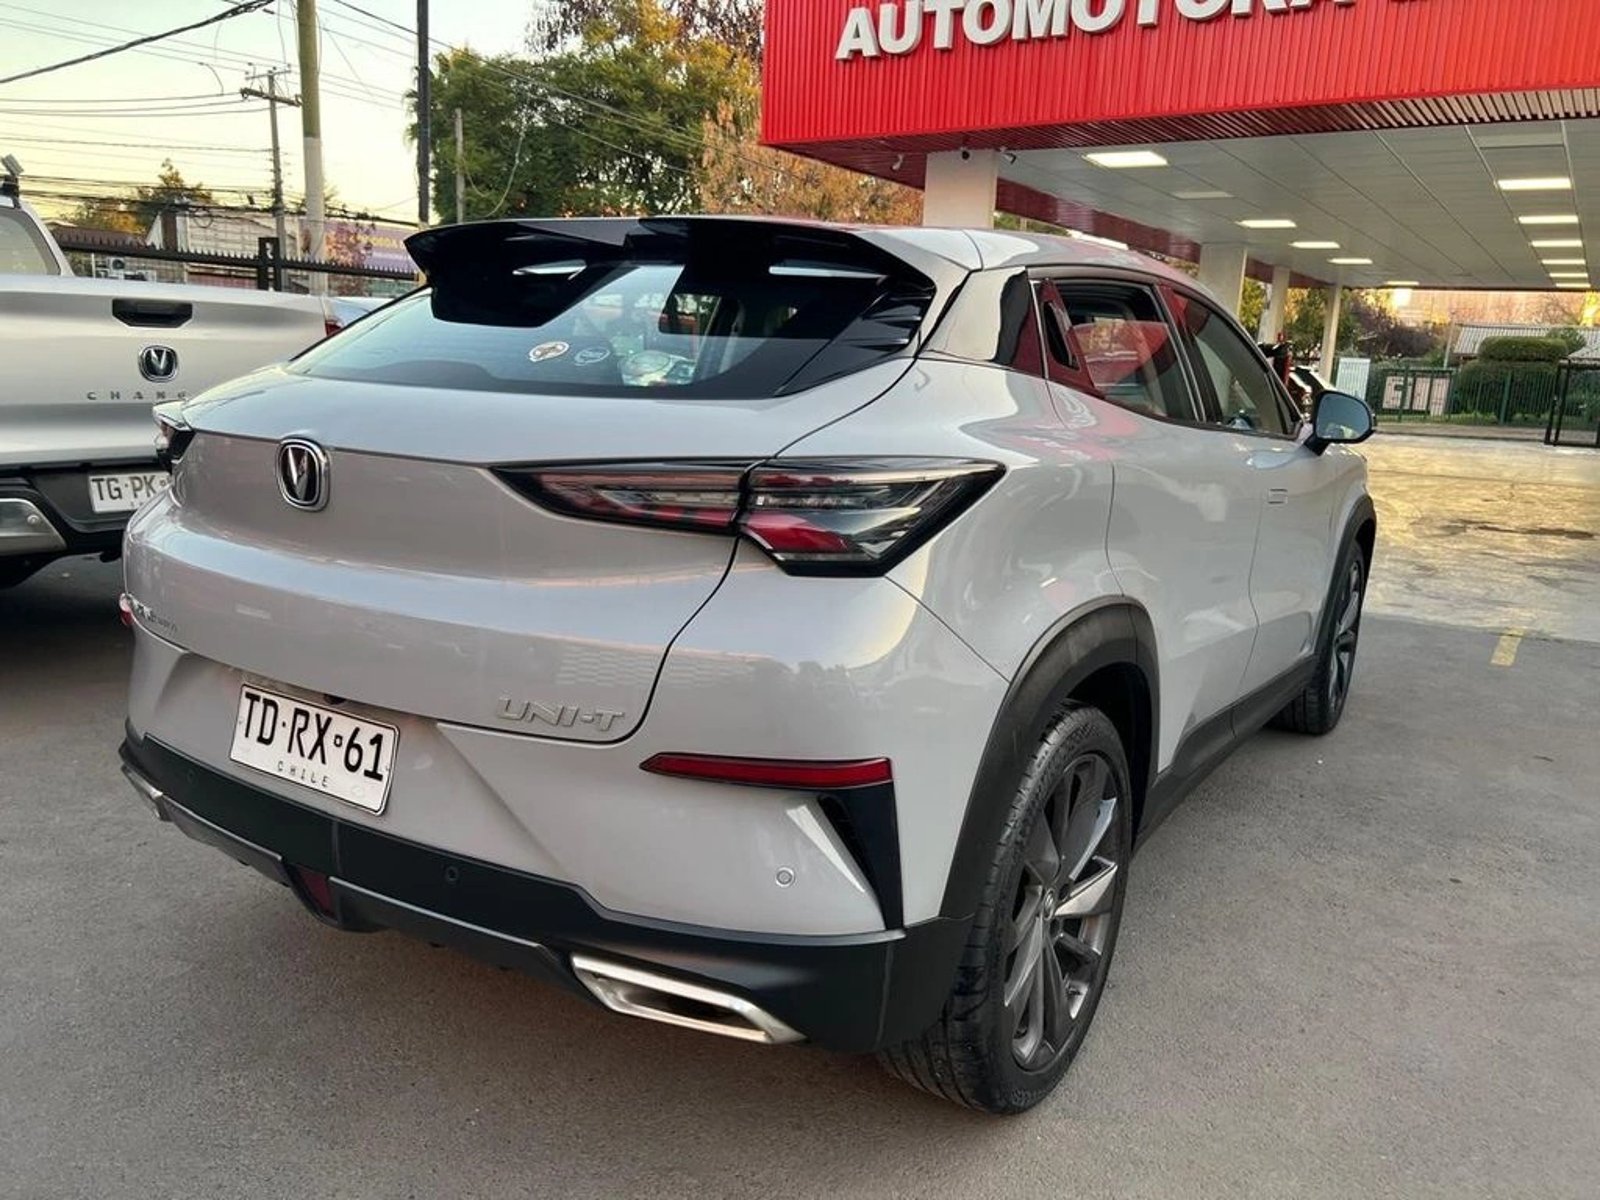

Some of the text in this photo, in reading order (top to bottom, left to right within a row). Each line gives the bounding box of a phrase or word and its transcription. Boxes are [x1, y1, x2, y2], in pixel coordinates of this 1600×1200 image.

[835, 0, 1353, 60] AUTOMO
[497, 697, 625, 732] UNI-T
[276, 760, 331, 788] CHILE
